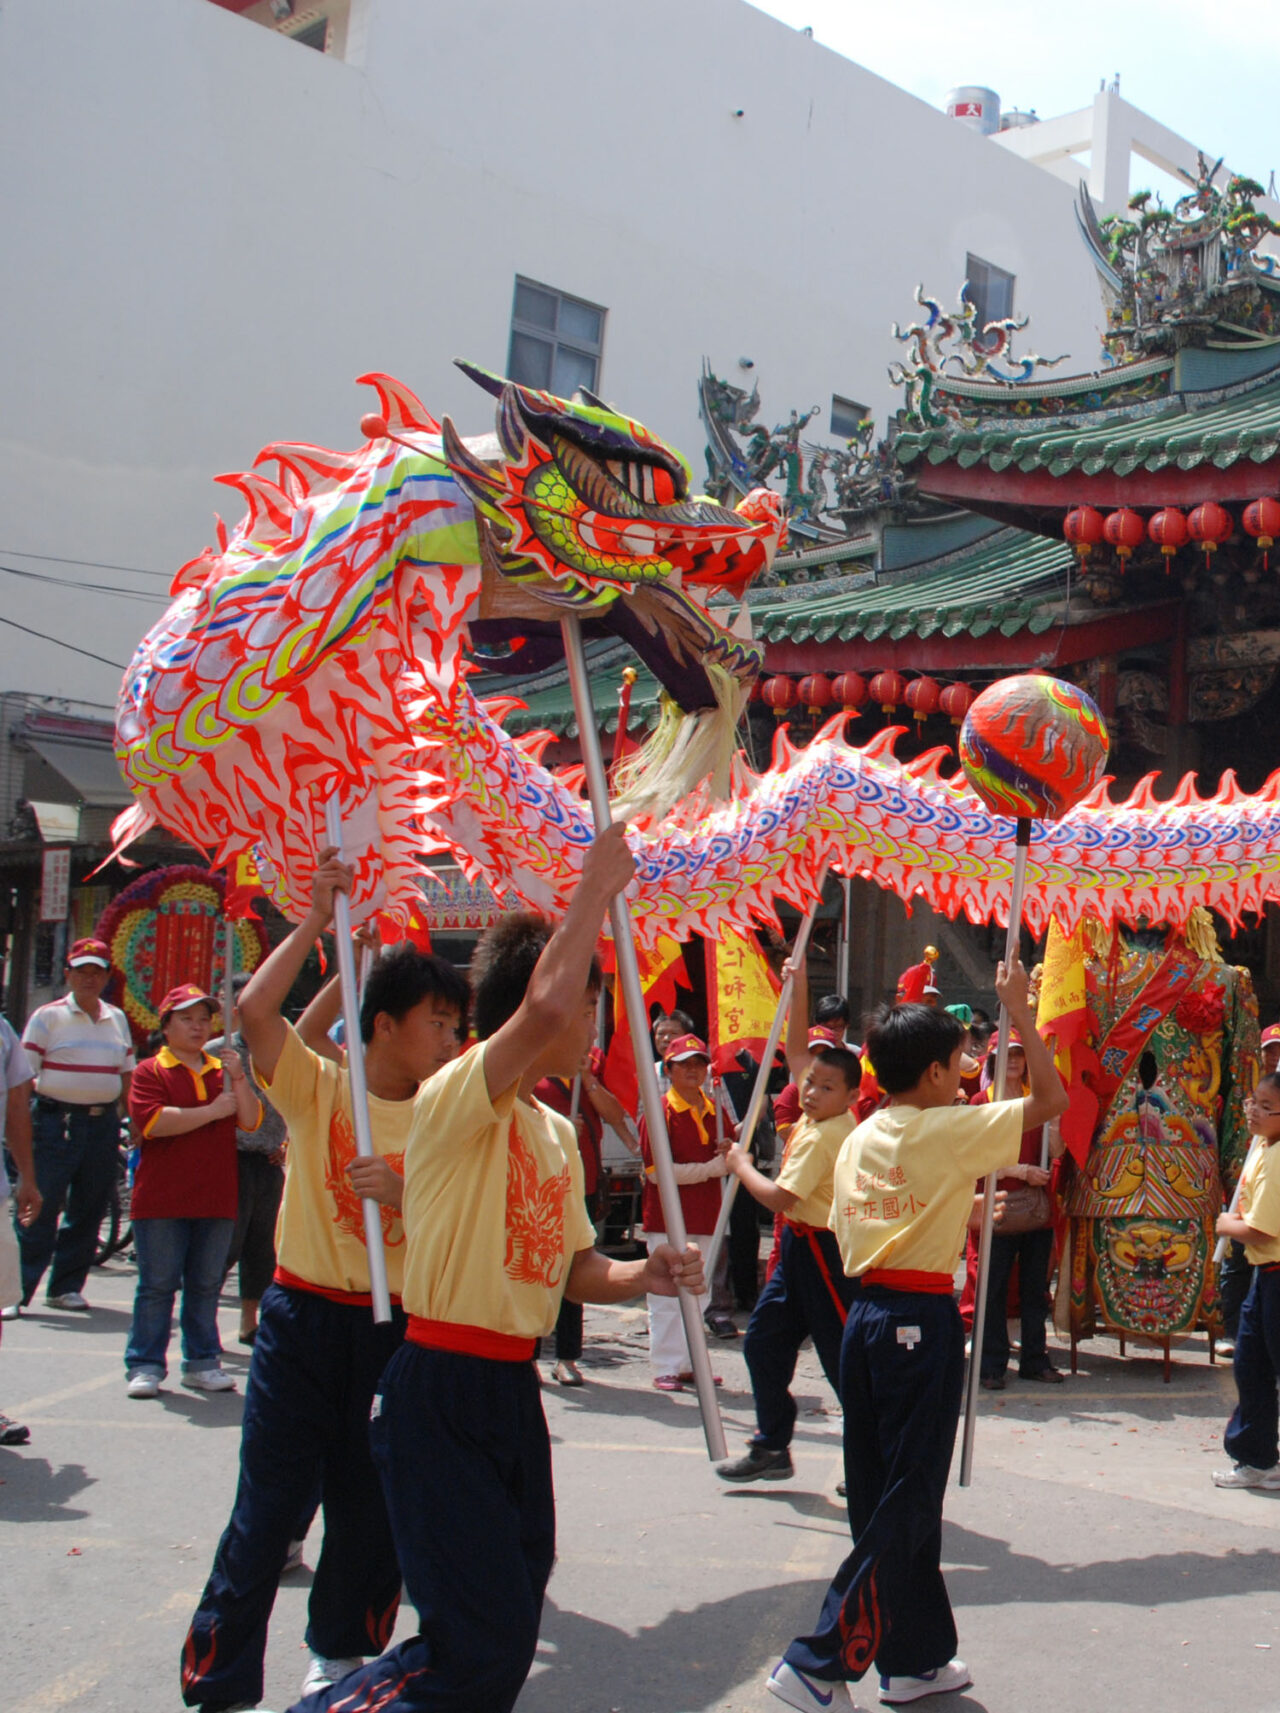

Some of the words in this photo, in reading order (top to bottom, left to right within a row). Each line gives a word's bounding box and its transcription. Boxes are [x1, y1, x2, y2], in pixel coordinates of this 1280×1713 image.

[722, 946, 746, 1034] 仁和宮
[1101, 963, 1190, 1078] 千里眼
[853, 1165, 907, 1192] 彰化縣
[843, 1193, 927, 1225] 中正國小
